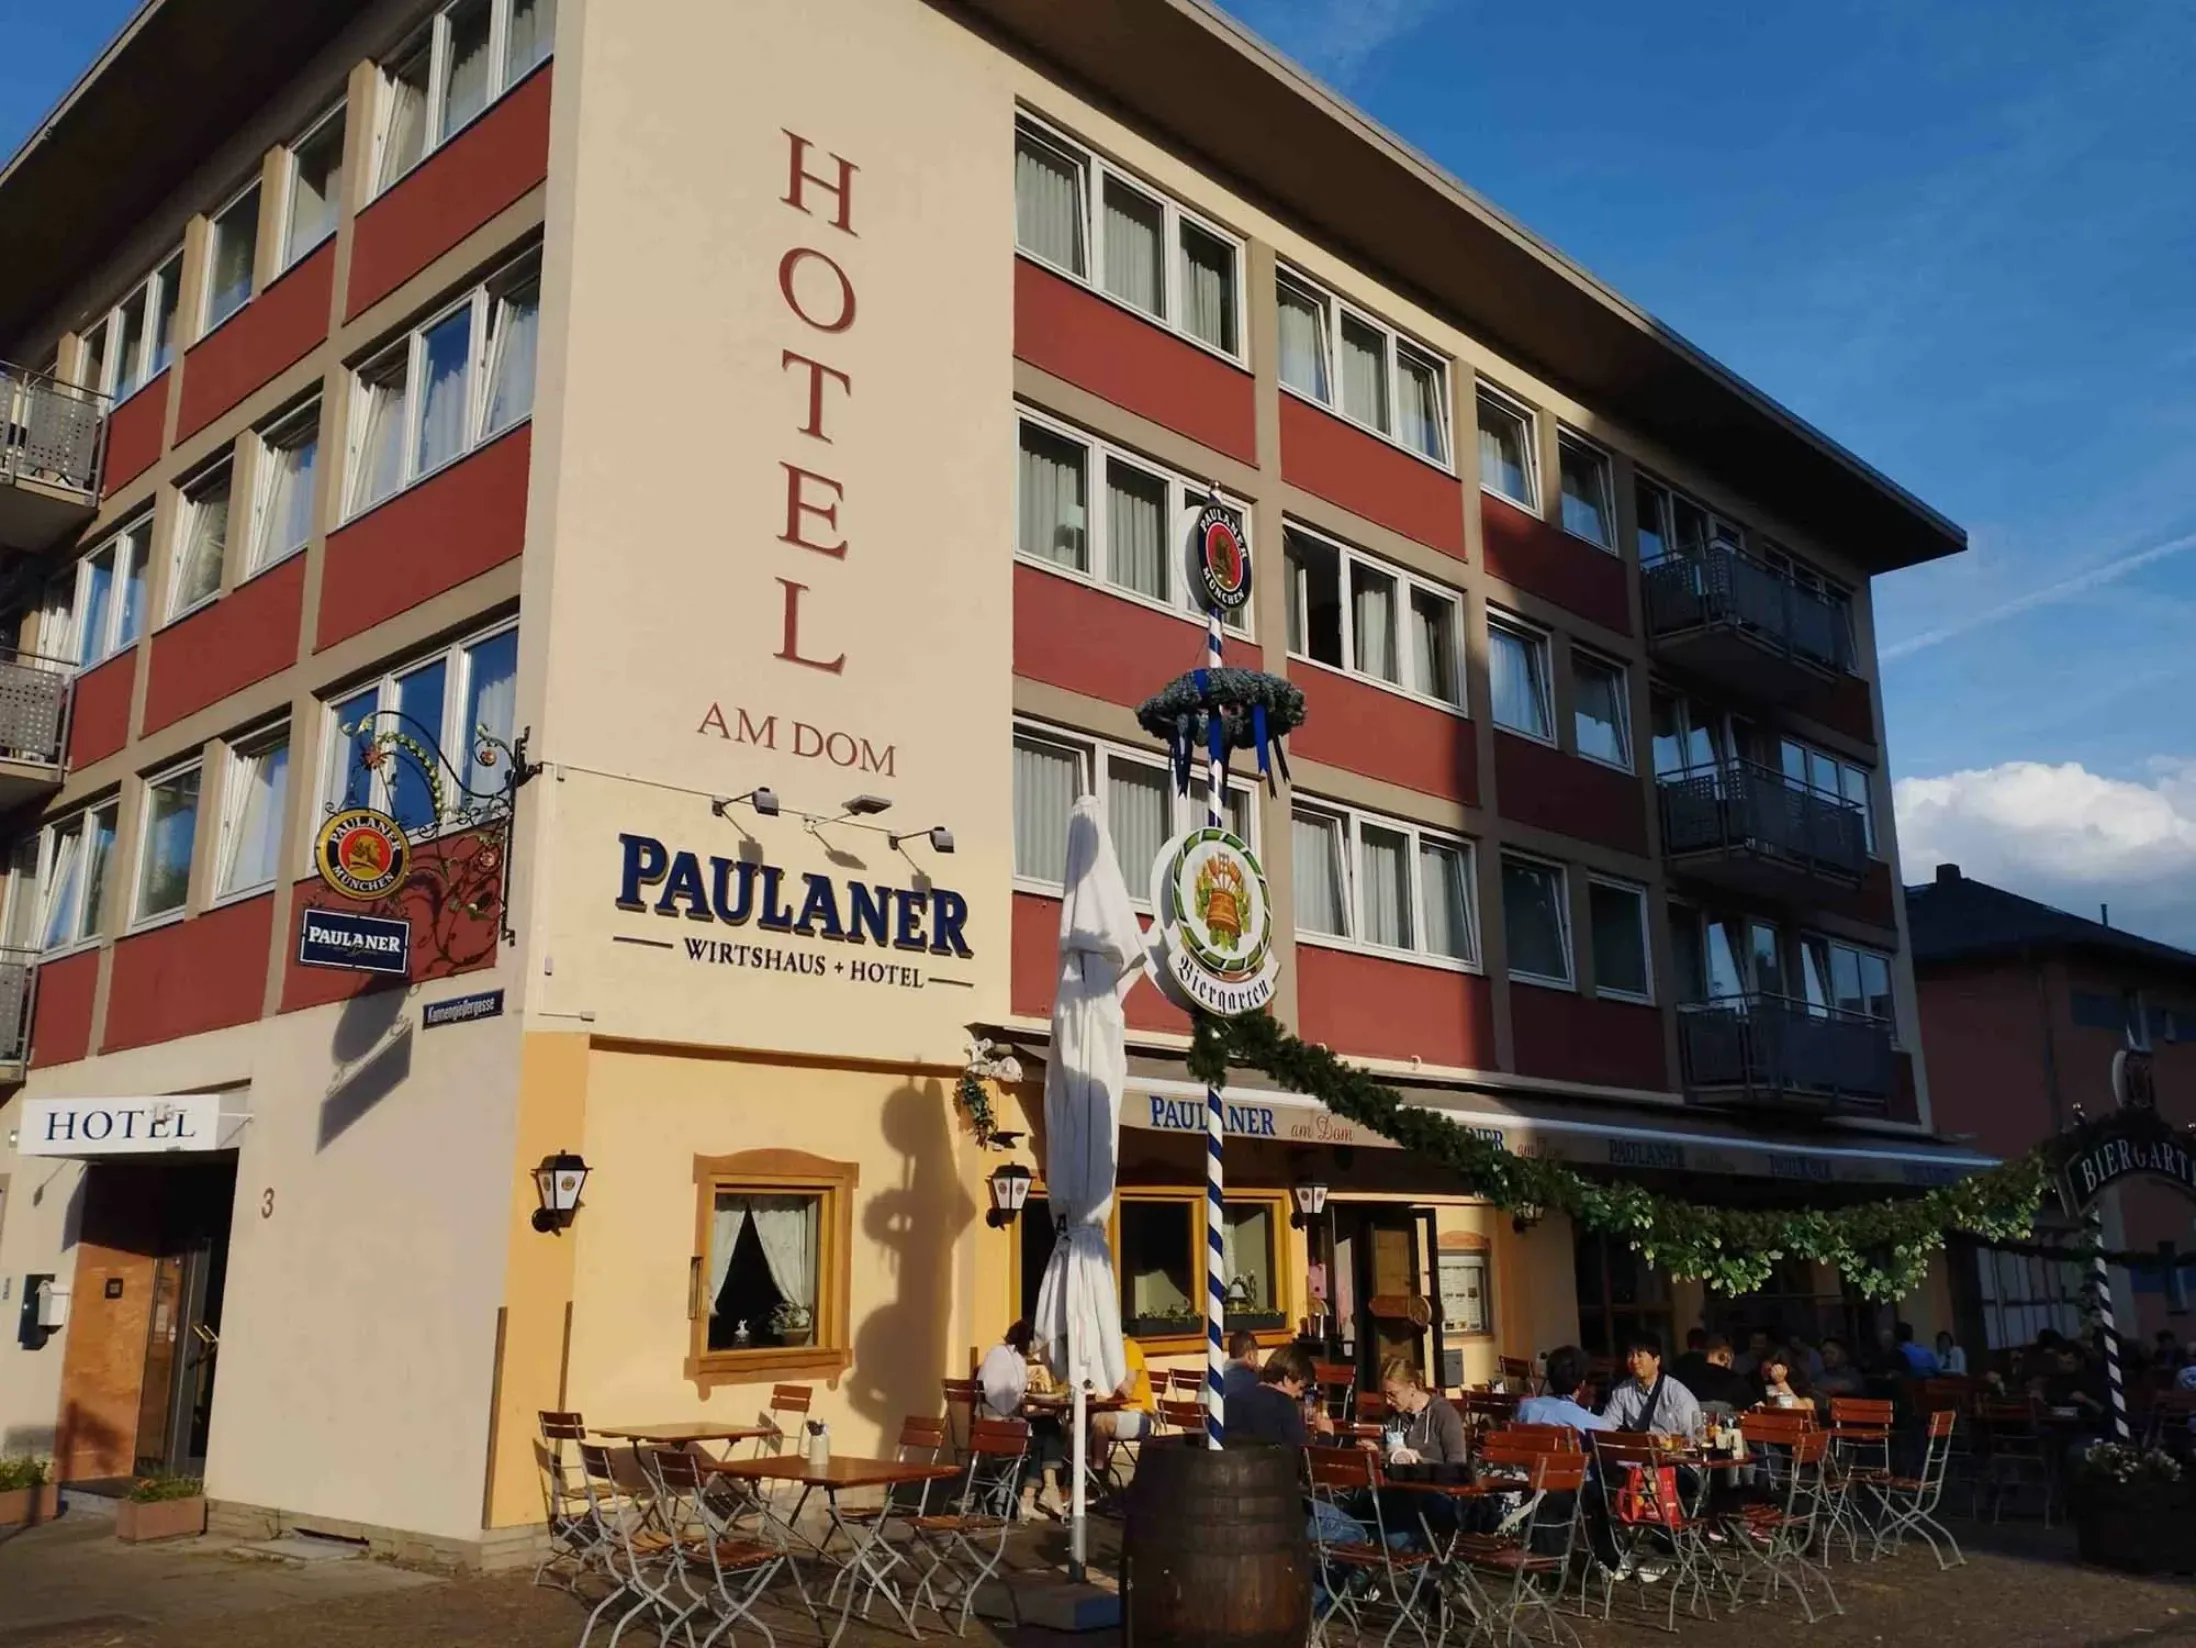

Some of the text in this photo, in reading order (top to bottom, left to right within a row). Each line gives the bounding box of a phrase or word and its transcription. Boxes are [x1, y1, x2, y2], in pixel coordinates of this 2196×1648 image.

[772, 127, 861, 676] HOTEL
[1199, 507, 1248, 560] PAULANER
[697, 701, 898, 778] AM DOM
[328, 816, 402, 852] PAULANER
[614, 833, 975, 959] PAULANER
[308, 925, 401, 953] PAULANER
[683, 937, 826, 976] WIRTSHAUS
[849, 960, 925, 989] HOTEL
[1177, 954, 1270, 1014] Biergarten
[43, 1109, 198, 1141] HOTEL
[1149, 1095, 1276, 1136] PAULNER
[1290, 1123, 1313, 1139] am
[261, 1187, 275, 1219] 3
